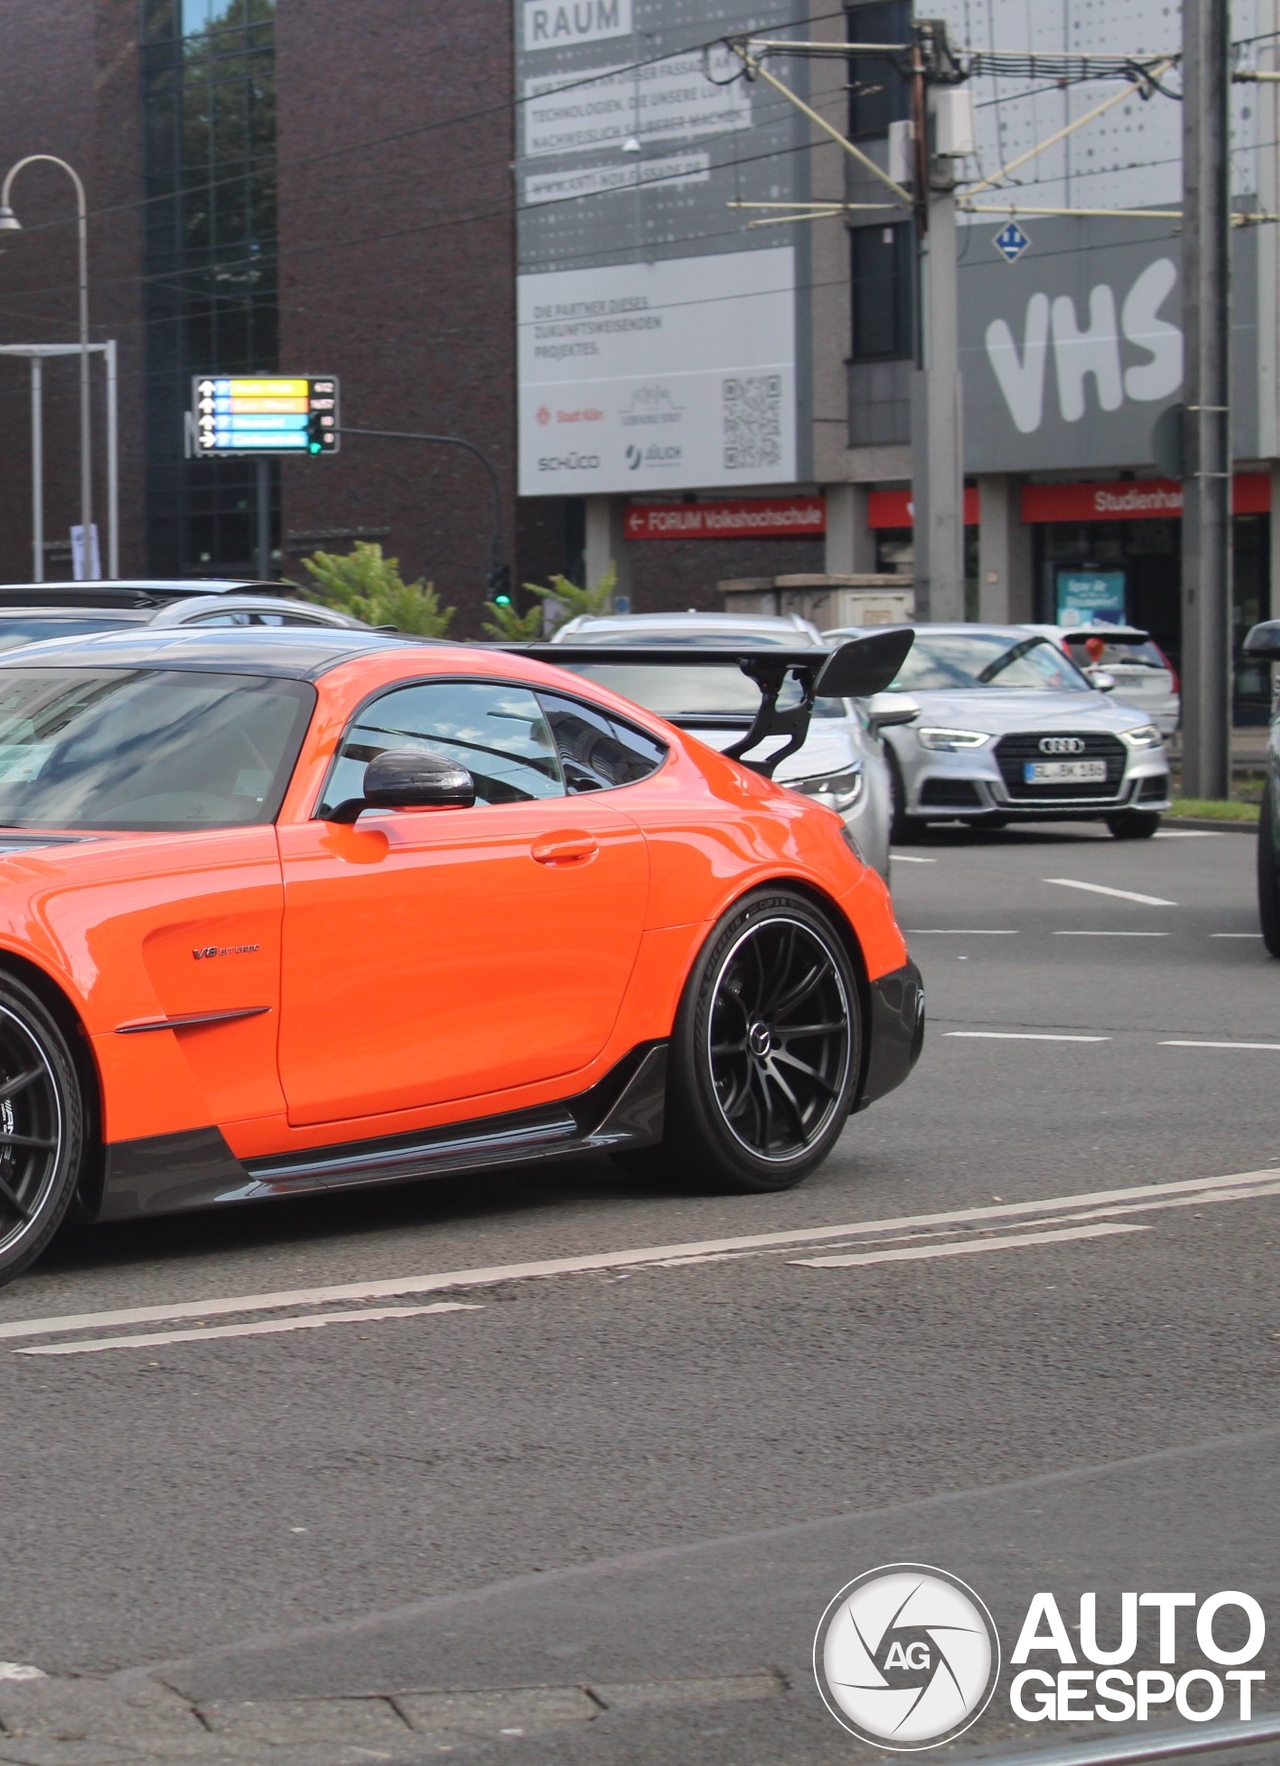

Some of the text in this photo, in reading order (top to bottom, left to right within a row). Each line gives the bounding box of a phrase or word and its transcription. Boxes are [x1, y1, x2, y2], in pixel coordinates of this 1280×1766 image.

[532, 0, 619, 41] RAUM
[985, 257, 1184, 434] VHS
[538, 451, 600, 472] SCHÜCO
[648, 505, 821, 531] FORUM Volkshochschule
[192, 946, 218, 960] V8
